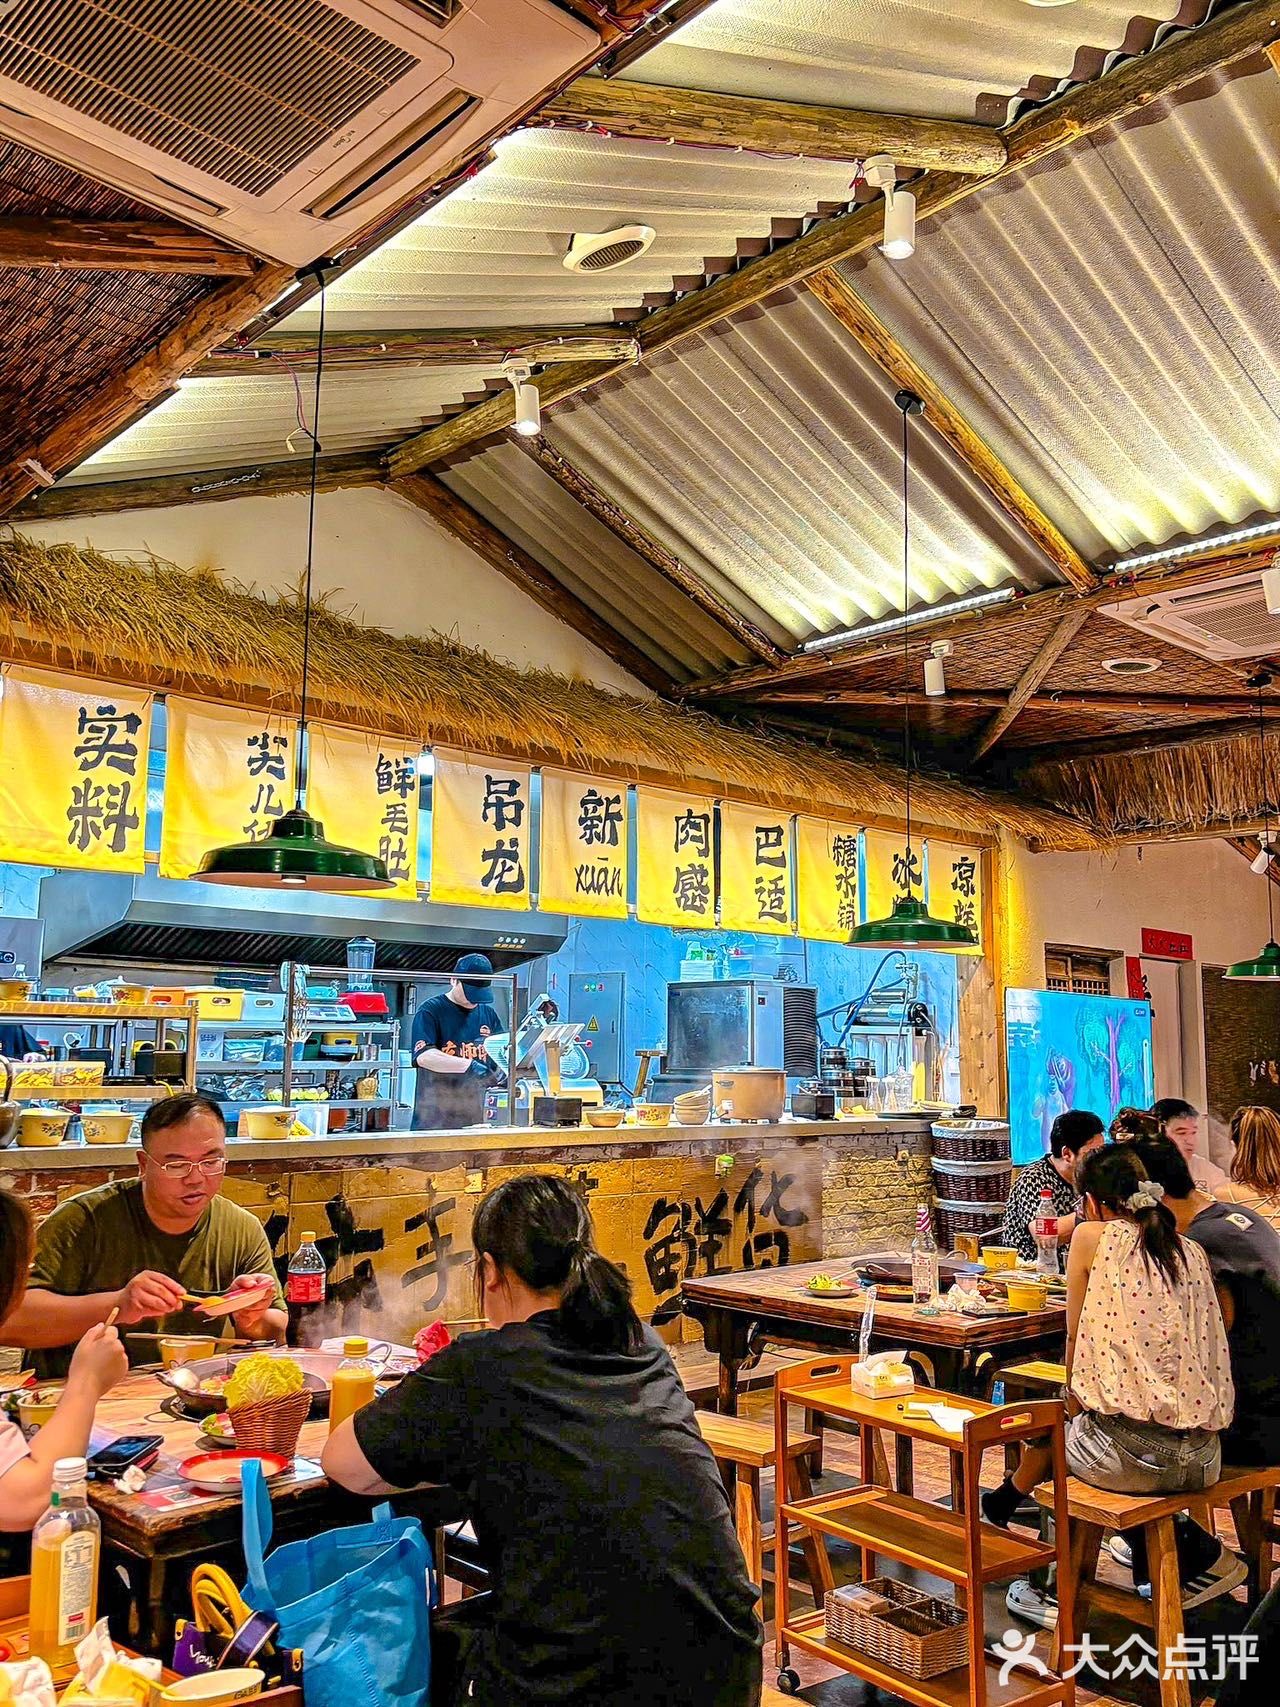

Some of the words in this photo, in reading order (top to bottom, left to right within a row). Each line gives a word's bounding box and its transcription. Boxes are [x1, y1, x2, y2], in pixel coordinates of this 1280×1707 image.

[67, 705, 142, 853] 实料
[374, 753, 416, 882] 鲜毛肚
[481, 774, 525, 894] 吊龙
[672, 808, 711, 915] 肉感
[754, 825, 788, 924] 巴适
